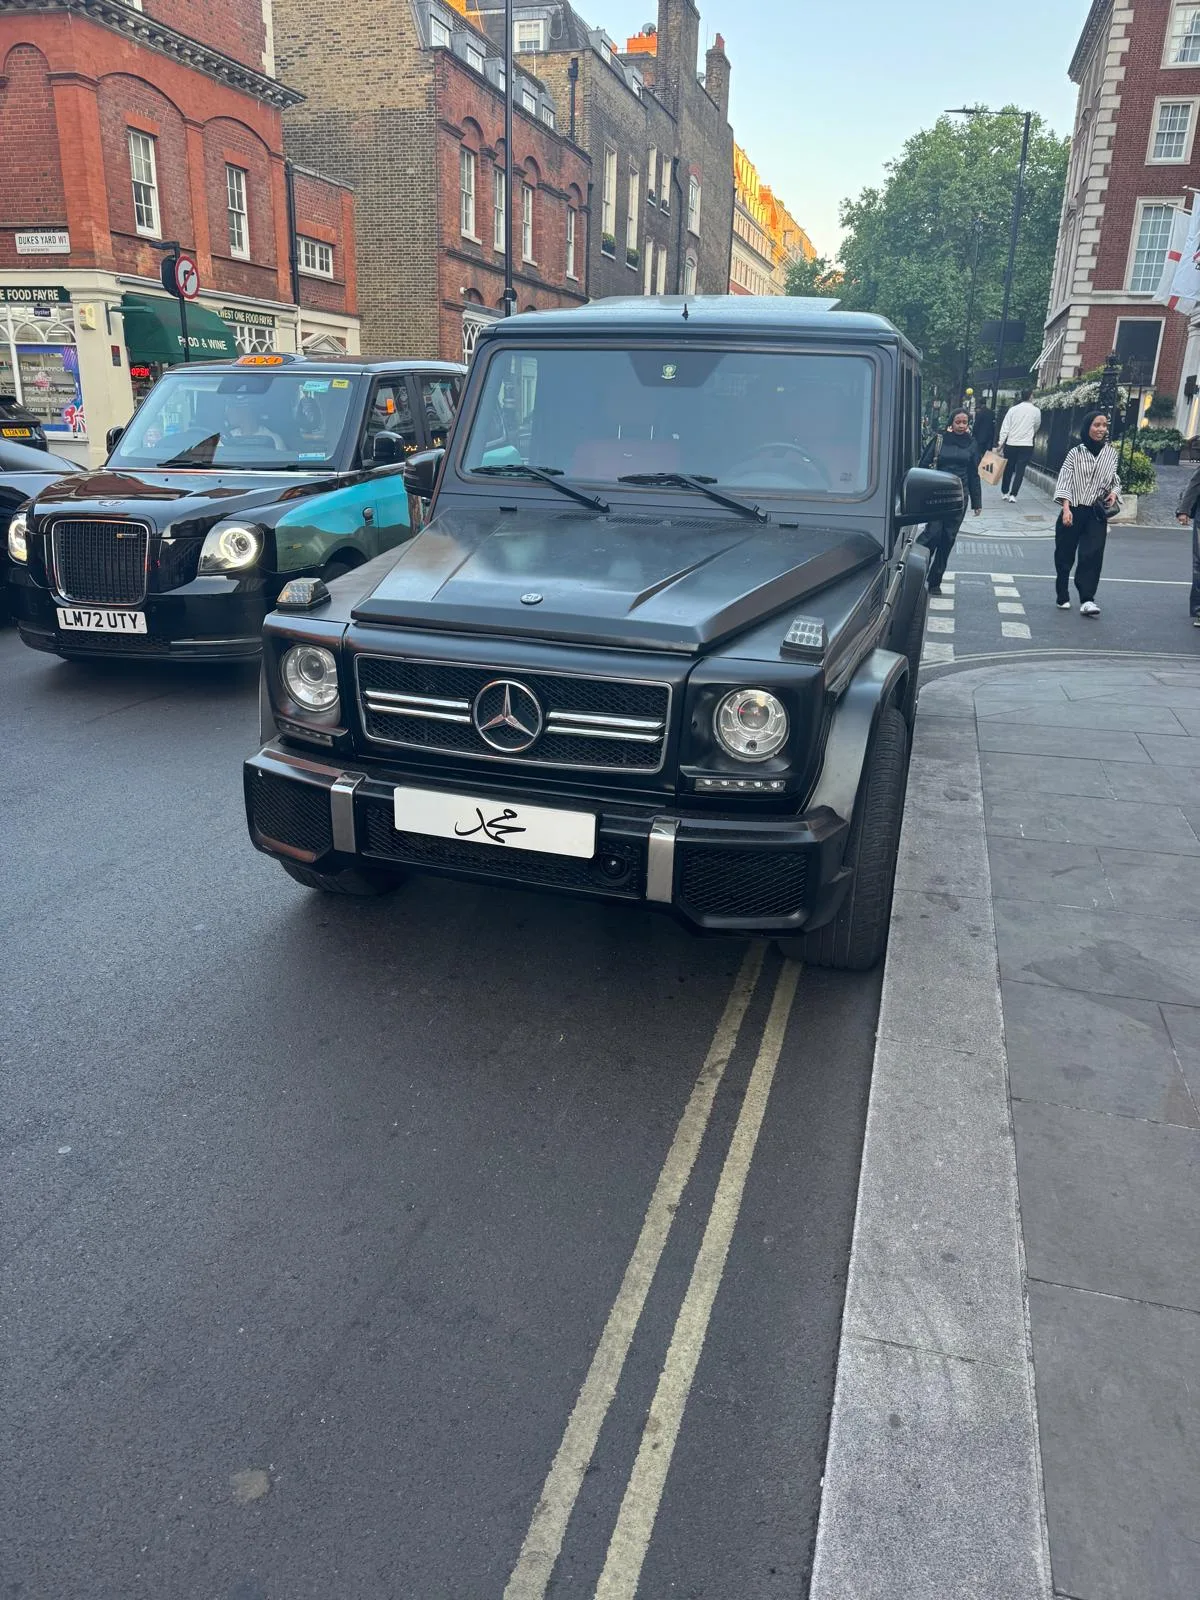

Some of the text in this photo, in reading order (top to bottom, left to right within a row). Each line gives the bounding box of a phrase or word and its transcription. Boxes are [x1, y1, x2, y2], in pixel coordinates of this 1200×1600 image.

[18, 235, 67, 245] DUKES YARD W1
[0, 289, 59, 301] E FOOD FAYRE
[220, 309, 273, 326] WEST ONE FOOD FAYRE
[201, 338, 208, 348] &
[208, 339, 228, 350] WINE
[131, 367, 150, 377] OPEN
[63, 610, 138, 629] LM72 UTY
[454, 807, 527, 844] محمد
